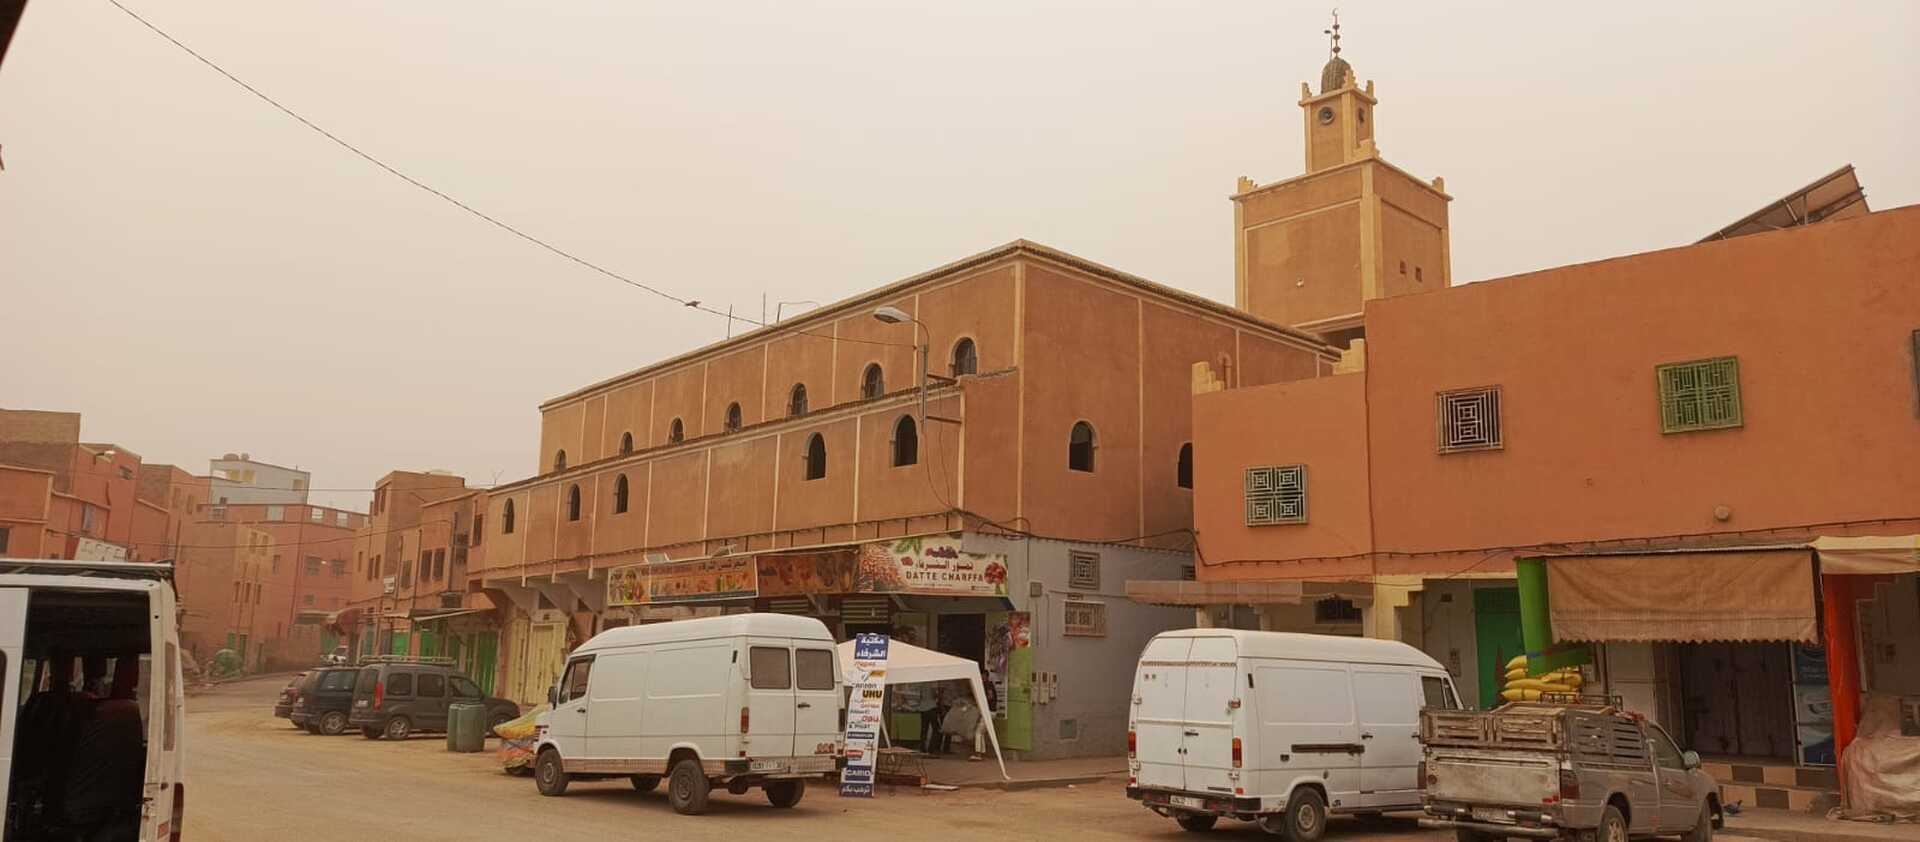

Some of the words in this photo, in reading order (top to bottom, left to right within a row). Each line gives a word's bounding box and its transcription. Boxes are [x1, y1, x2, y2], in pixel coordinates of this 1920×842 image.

[906, 571, 937, 580] DATTE
[941, 572, 983, 581] CHARFFA
[861, 635, 885, 646] مكتبة
[856, 647, 886, 659] الشرفاء
[862, 689, 883, 698] UHU
